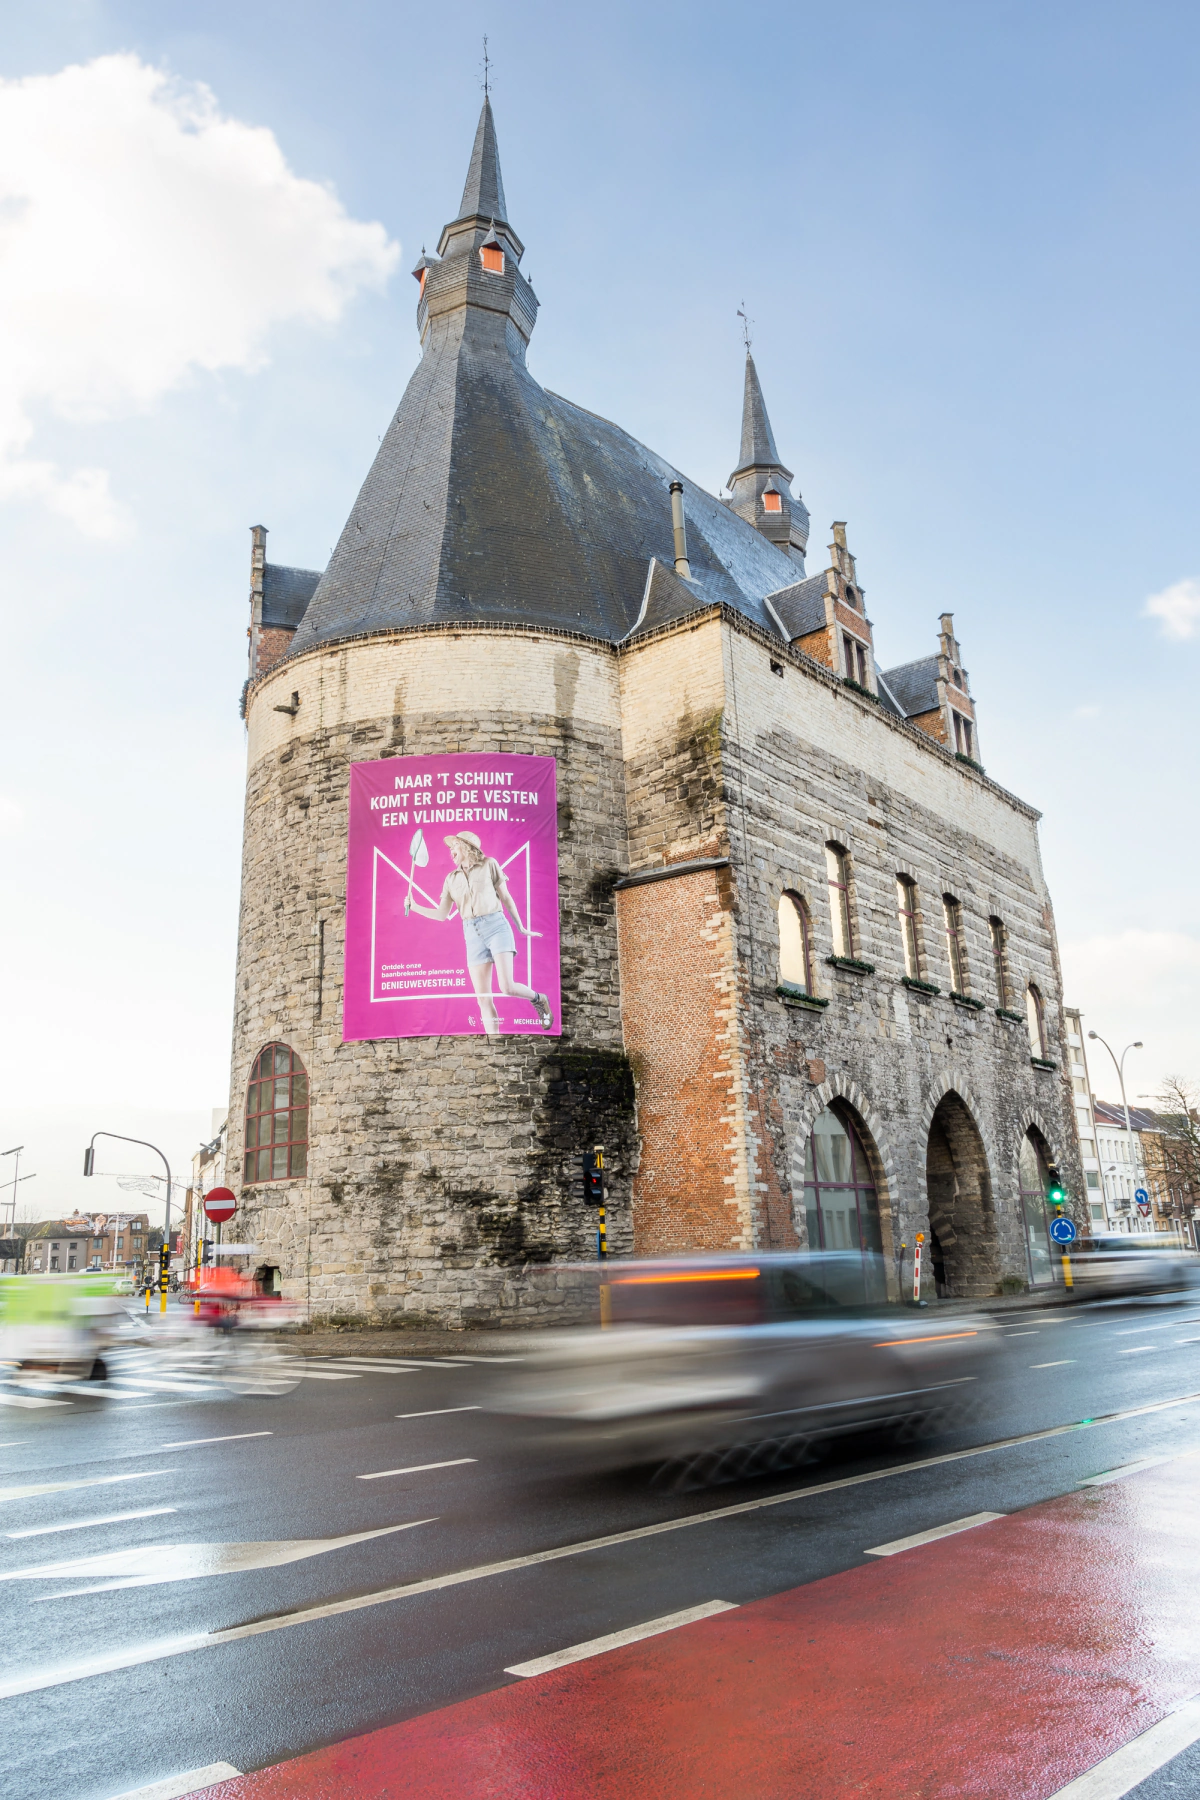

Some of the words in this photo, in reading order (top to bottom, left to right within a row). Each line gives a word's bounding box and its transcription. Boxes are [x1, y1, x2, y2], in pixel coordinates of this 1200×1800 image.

[394, 774, 433, 790] NAAR
[437, 773, 450, 786] 'T
[454, 772, 514, 786] SCHIJNT
[370, 793, 410, 810] KOMT
[414, 792, 432, 805] ER
[436, 790, 456, 804] OP
[460, 790, 479, 803] DE
[483, 790, 539, 805] VESTEN
[382, 811, 408, 827] EEN
[381, 963, 405, 971] Ontdek
[381, 969, 427, 978] baanbrekende
[428, 968, 455, 976] plannen
[381, 978, 466, 990] DENIEUWEVESTEN.BE
